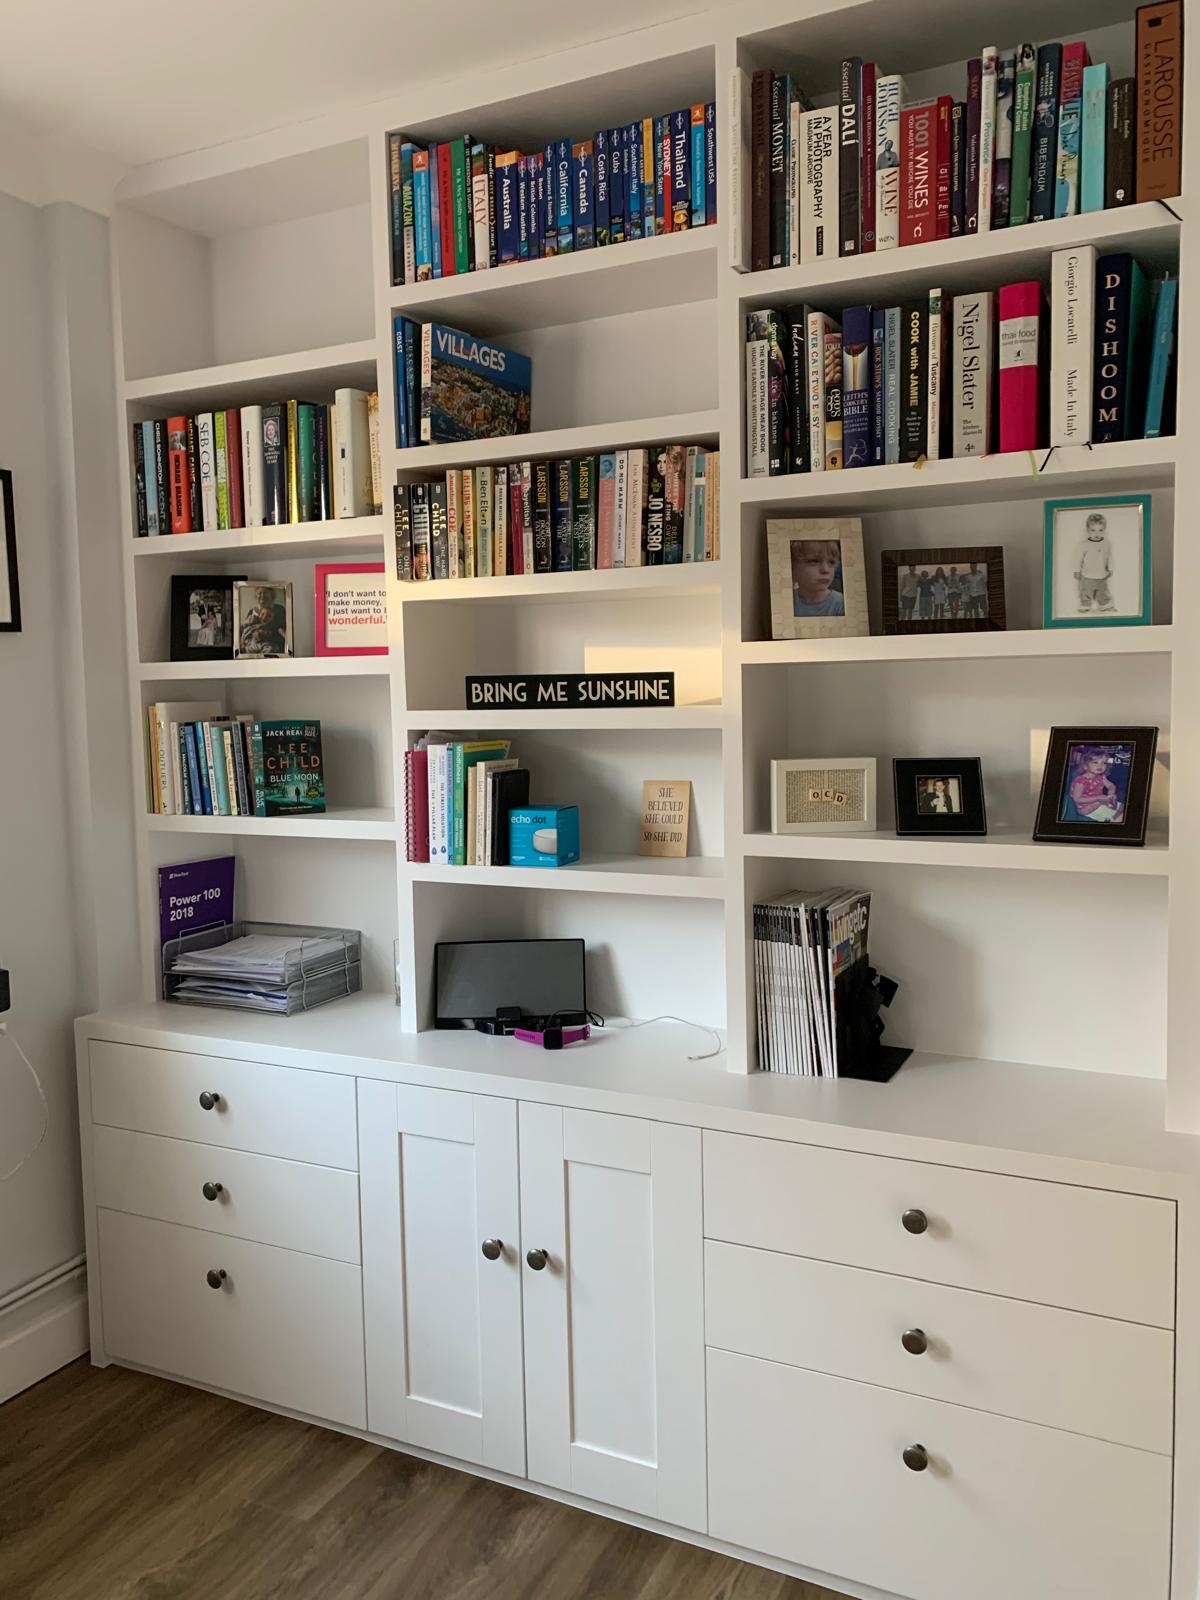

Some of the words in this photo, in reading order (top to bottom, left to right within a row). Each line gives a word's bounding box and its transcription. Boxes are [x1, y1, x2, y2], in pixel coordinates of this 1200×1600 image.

[841, 61, 852, 102] Essential
[1015, 83, 1023, 109] Cookery
[1022, 82, 1031, 110] Complete
[772, 81, 781, 120] Essential
[877, 82, 889, 146] JOHNSON
[887, 82, 899, 122] HUGH
[1142, 43, 1151, 164] GASTRONOMIQUE
[1152, 37, 1176, 162] LAROUSSE
[813, 117, 822, 125] IN
[822, 116, 832, 124] A
[841, 103, 859, 146] DALÍ
[914, 110, 929, 148] 1001
[1015, 110, 1023, 132] Course
[1022, 111, 1030, 131] Italian
[662, 138, 671, 176] SYDNEY
[707, 127, 715, 167] Southwest
[772, 121, 784, 173] MONET
[823, 126, 832, 157] YEAR
[597, 153, 606, 177] Costa
[612, 151, 620, 173] Cuba
[675, 131, 687, 189] Thailand
[813, 126, 823, 219] PHOTOGRAPHY
[1037, 137, 1049, 192] BIBENDUM
[559, 161, 568, 216] California
[579, 168, 589, 214] Canada
[598, 183, 607, 201] Rica
[631, 178, 639, 194] Italy
[884, 170, 898, 215] WINE
[914, 151, 929, 208] WINES
[402, 186, 413, 225] AMAZON
[474, 179, 487, 225] ITALY
[502, 178, 511, 230] Australia
[1064, 256, 1079, 296] Giorgio
[770, 322, 779, 342] donna
[810, 319, 819, 348] RIVER
[888, 313, 896, 338] NIGEL
[910, 311, 919, 344] COOK
[956, 303, 980, 351] Nigel
[1066, 299, 1079, 345] Locatelli
[423, 329, 431, 375] VILLAGES
[436, 330, 506, 372] VILLAGES
[791, 323, 804, 357] Indian
[888, 340, 896, 370] SLATER
[1099, 273, 1121, 422] DISHOOM
[910, 346, 919, 370] with
[811, 378, 819, 402] TWO
[888, 374, 896, 397] REAL
[910, 373, 919, 407] JAMIE
[962, 355, 980, 410] Slater
[1066, 370, 1078, 397] Made
[771, 398, 778, 408] in
[812, 404, 820, 428] EASY
[826, 389, 842, 417] eggs
[843, 405, 869, 417] BIBLE
[1066, 400, 1078, 411] In
[199, 422, 209, 447] SEB
[1064, 415, 1078, 438] Italy
[201, 450, 211, 483] COE
[579, 461, 589, 499] LARSSON
[537, 465, 546, 503] LARSSON
[559, 464, 569, 502] LARSSON
[672, 471, 680, 498] WHERE
[158, 486, 166, 520] ASCENT
[521, 483, 530, 527] Khayelitsha
[648, 494, 664, 510] JO
[394, 503, 403, 537] CHILD
[413, 503, 429, 544] CHILD
[432, 502, 440, 537] CHILD
[439, 509, 447, 529] LEE
[647, 513, 663, 552] NESBO
[333, 590, 354, 598] don't
[332, 608, 348, 616] just
[472, 682, 527, 703] BRING
[537, 681, 568, 702] ME
[578, 679, 670, 701] SUNSHINE
[267, 755, 320, 770] CHILD
[278, 743, 308, 754] LEE
[159, 749, 168, 790] OUTLIERS
[270, 774, 291, 783] BLUE
[294, 773, 319, 781] MOON
[647, 800, 684, 811] BELIEVED
[658, 787, 673, 798] SHE
[510, 814, 531, 824] echo
[532, 815, 547, 824] dot
[644, 814, 660, 824] SHE
[661, 814, 684, 825] COULD
[643, 831, 653, 841] SO
[653, 831, 669, 842] SHE
[670, 831, 683, 843] DID
[169, 893, 202, 908] Power
[203, 887, 221, 901] 100
[170, 906, 194, 922] 2018
